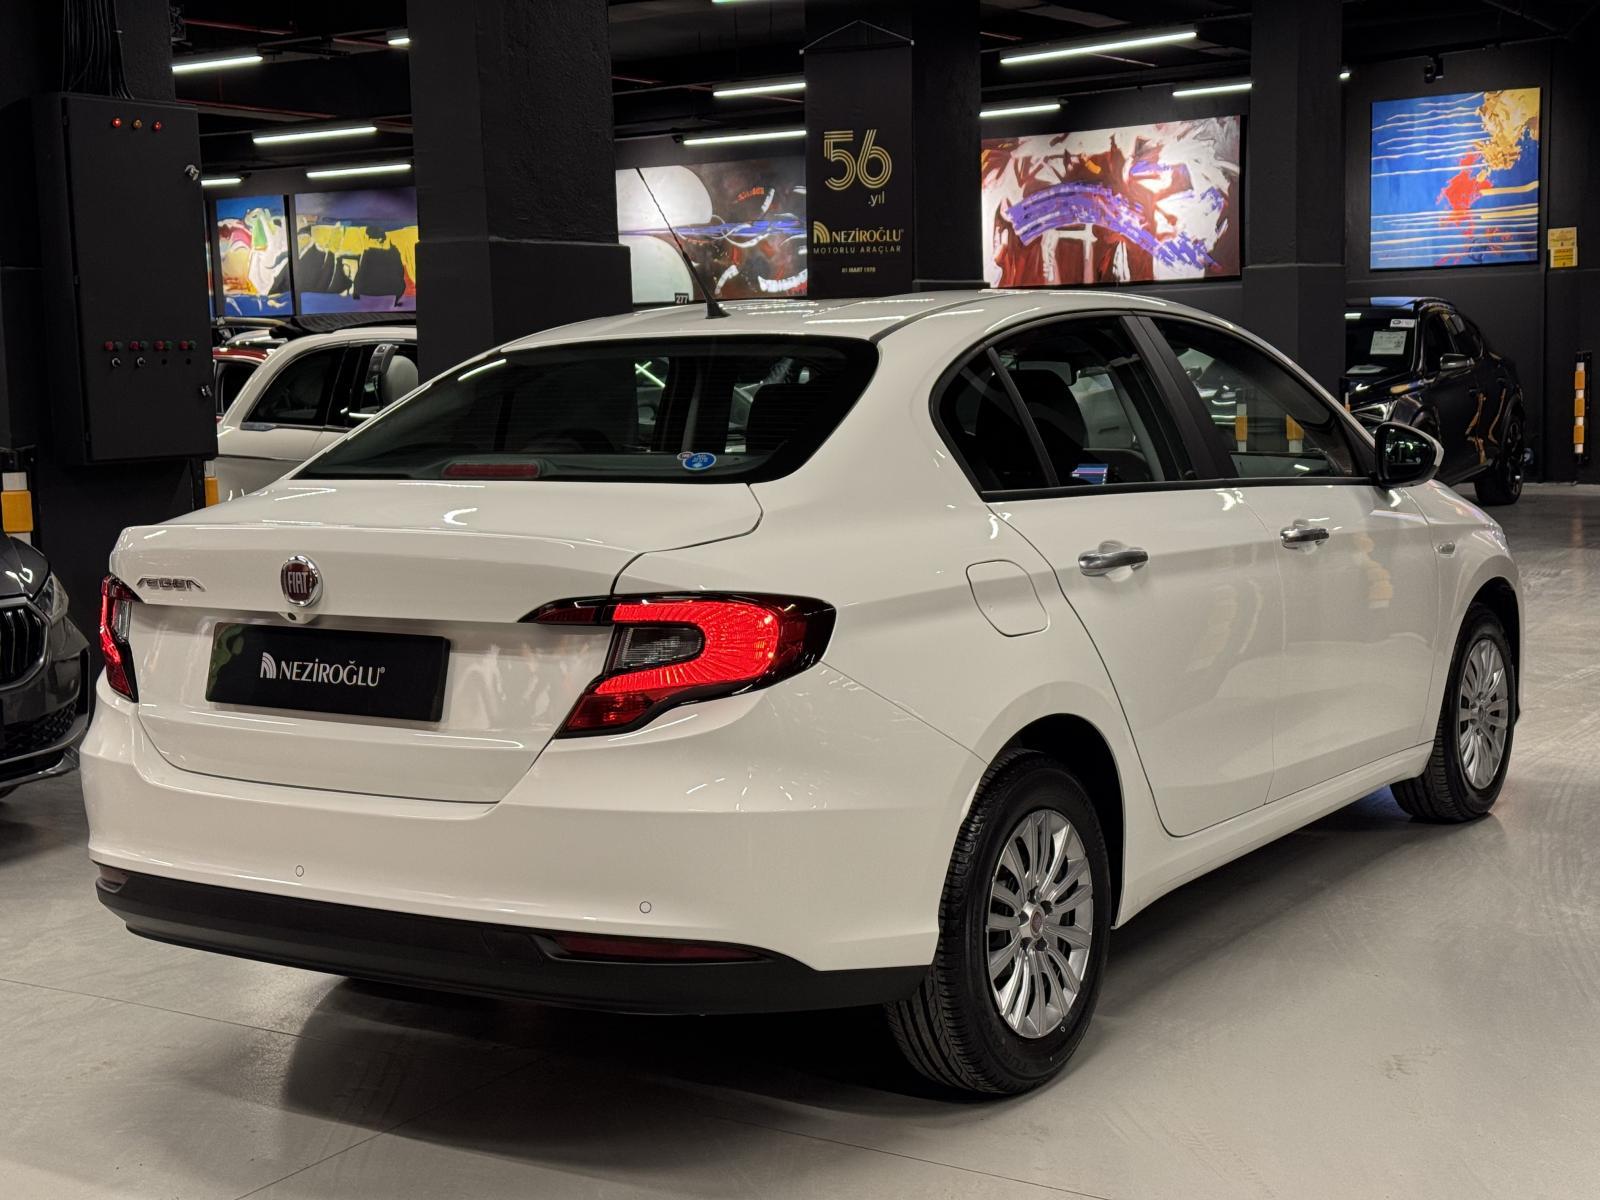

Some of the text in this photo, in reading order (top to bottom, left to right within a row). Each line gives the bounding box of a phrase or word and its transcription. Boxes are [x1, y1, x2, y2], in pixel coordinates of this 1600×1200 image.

[823, 129, 893, 191] 56
[832, 227, 901, 243] NEZİROĞLU
[813, 245, 901, 254] MOTORLU ARAÇLAR
[287, 571, 309, 594] FIAT
[279, 658, 381, 687] NEZİROĞLU
